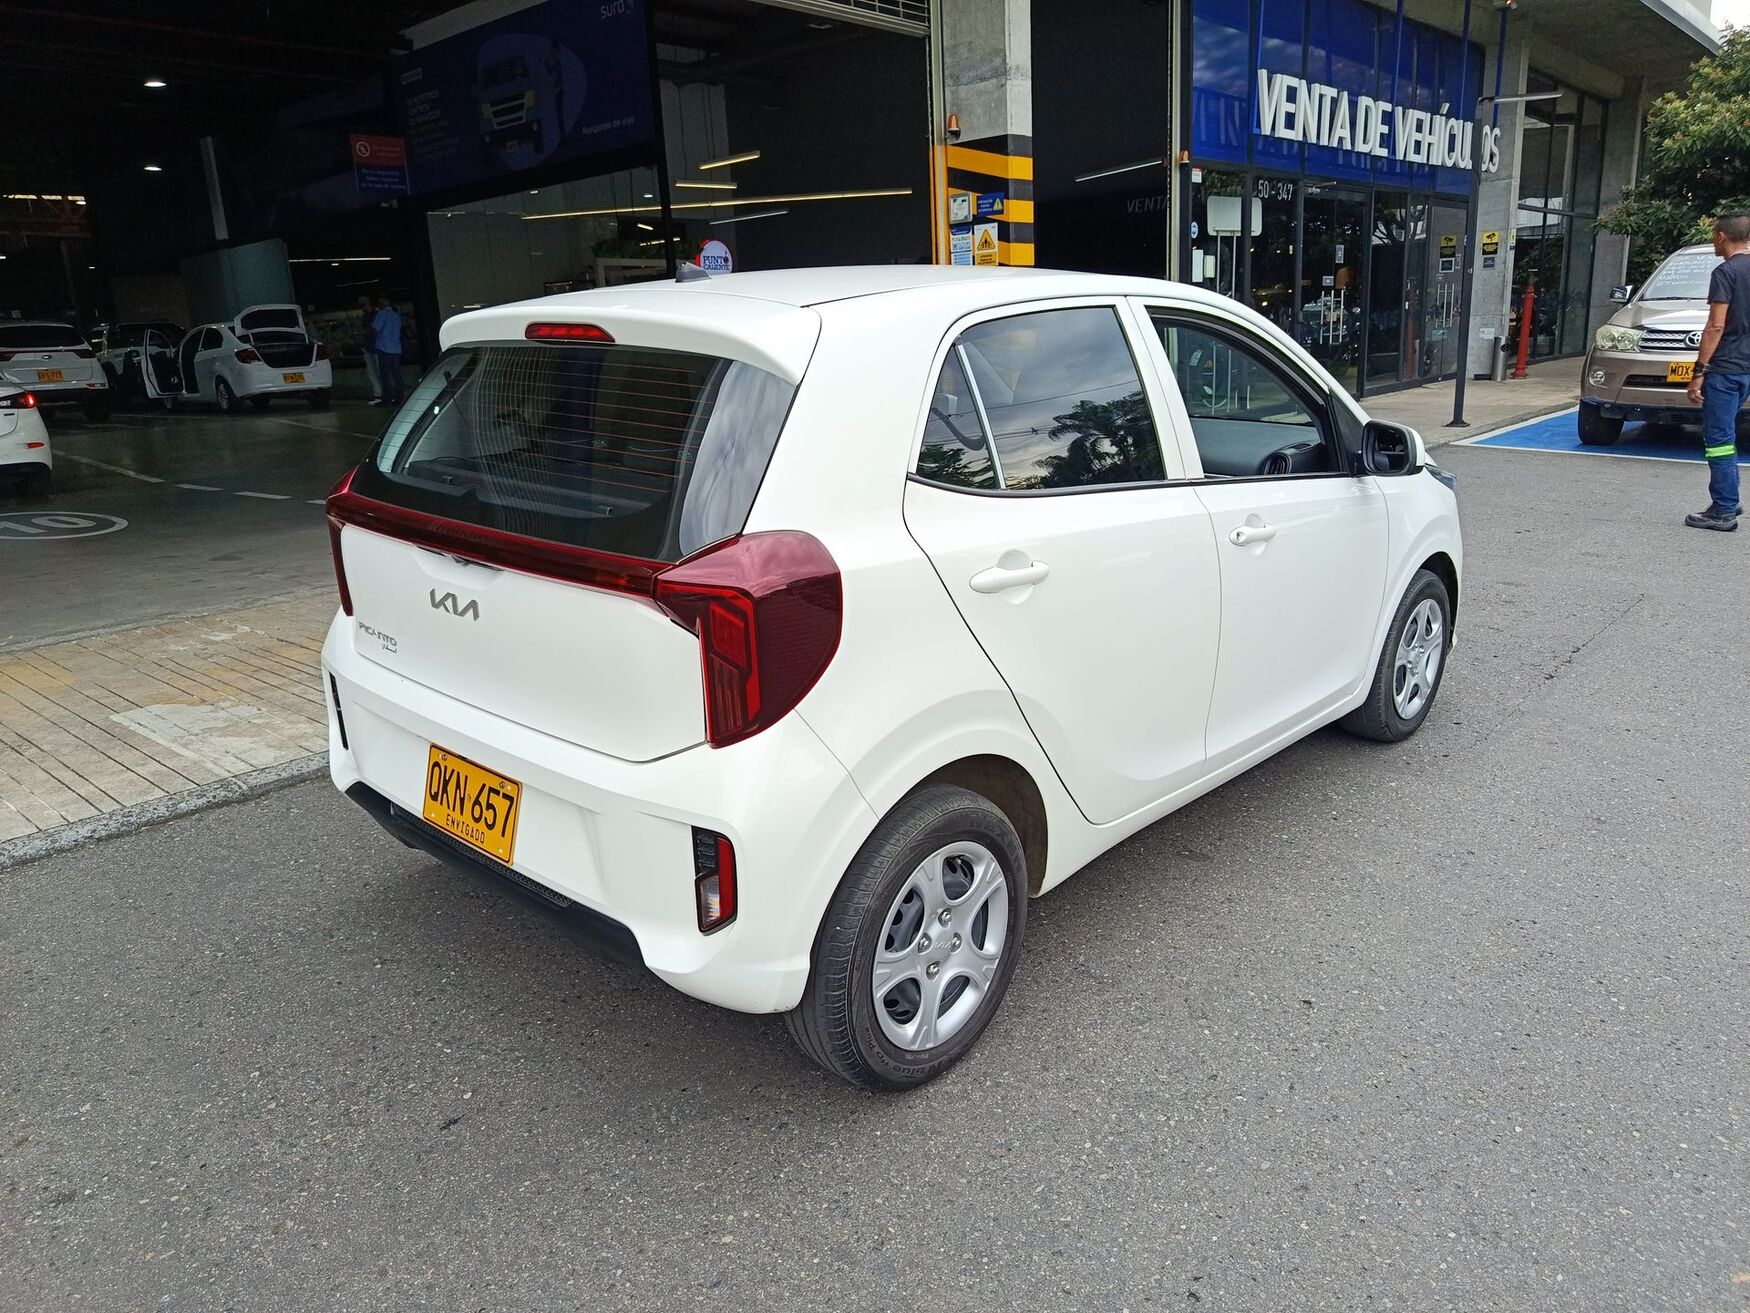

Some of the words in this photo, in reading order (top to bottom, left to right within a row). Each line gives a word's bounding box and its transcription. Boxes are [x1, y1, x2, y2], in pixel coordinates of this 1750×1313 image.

[1257, 69, 1351, 150] VENTA
[1354, 96, 1393, 157] DE
[429, 588, 480, 621] KIA
[359, 621, 398, 647] PICANTO
[445, 813, 486, 844] ENVIGADO
